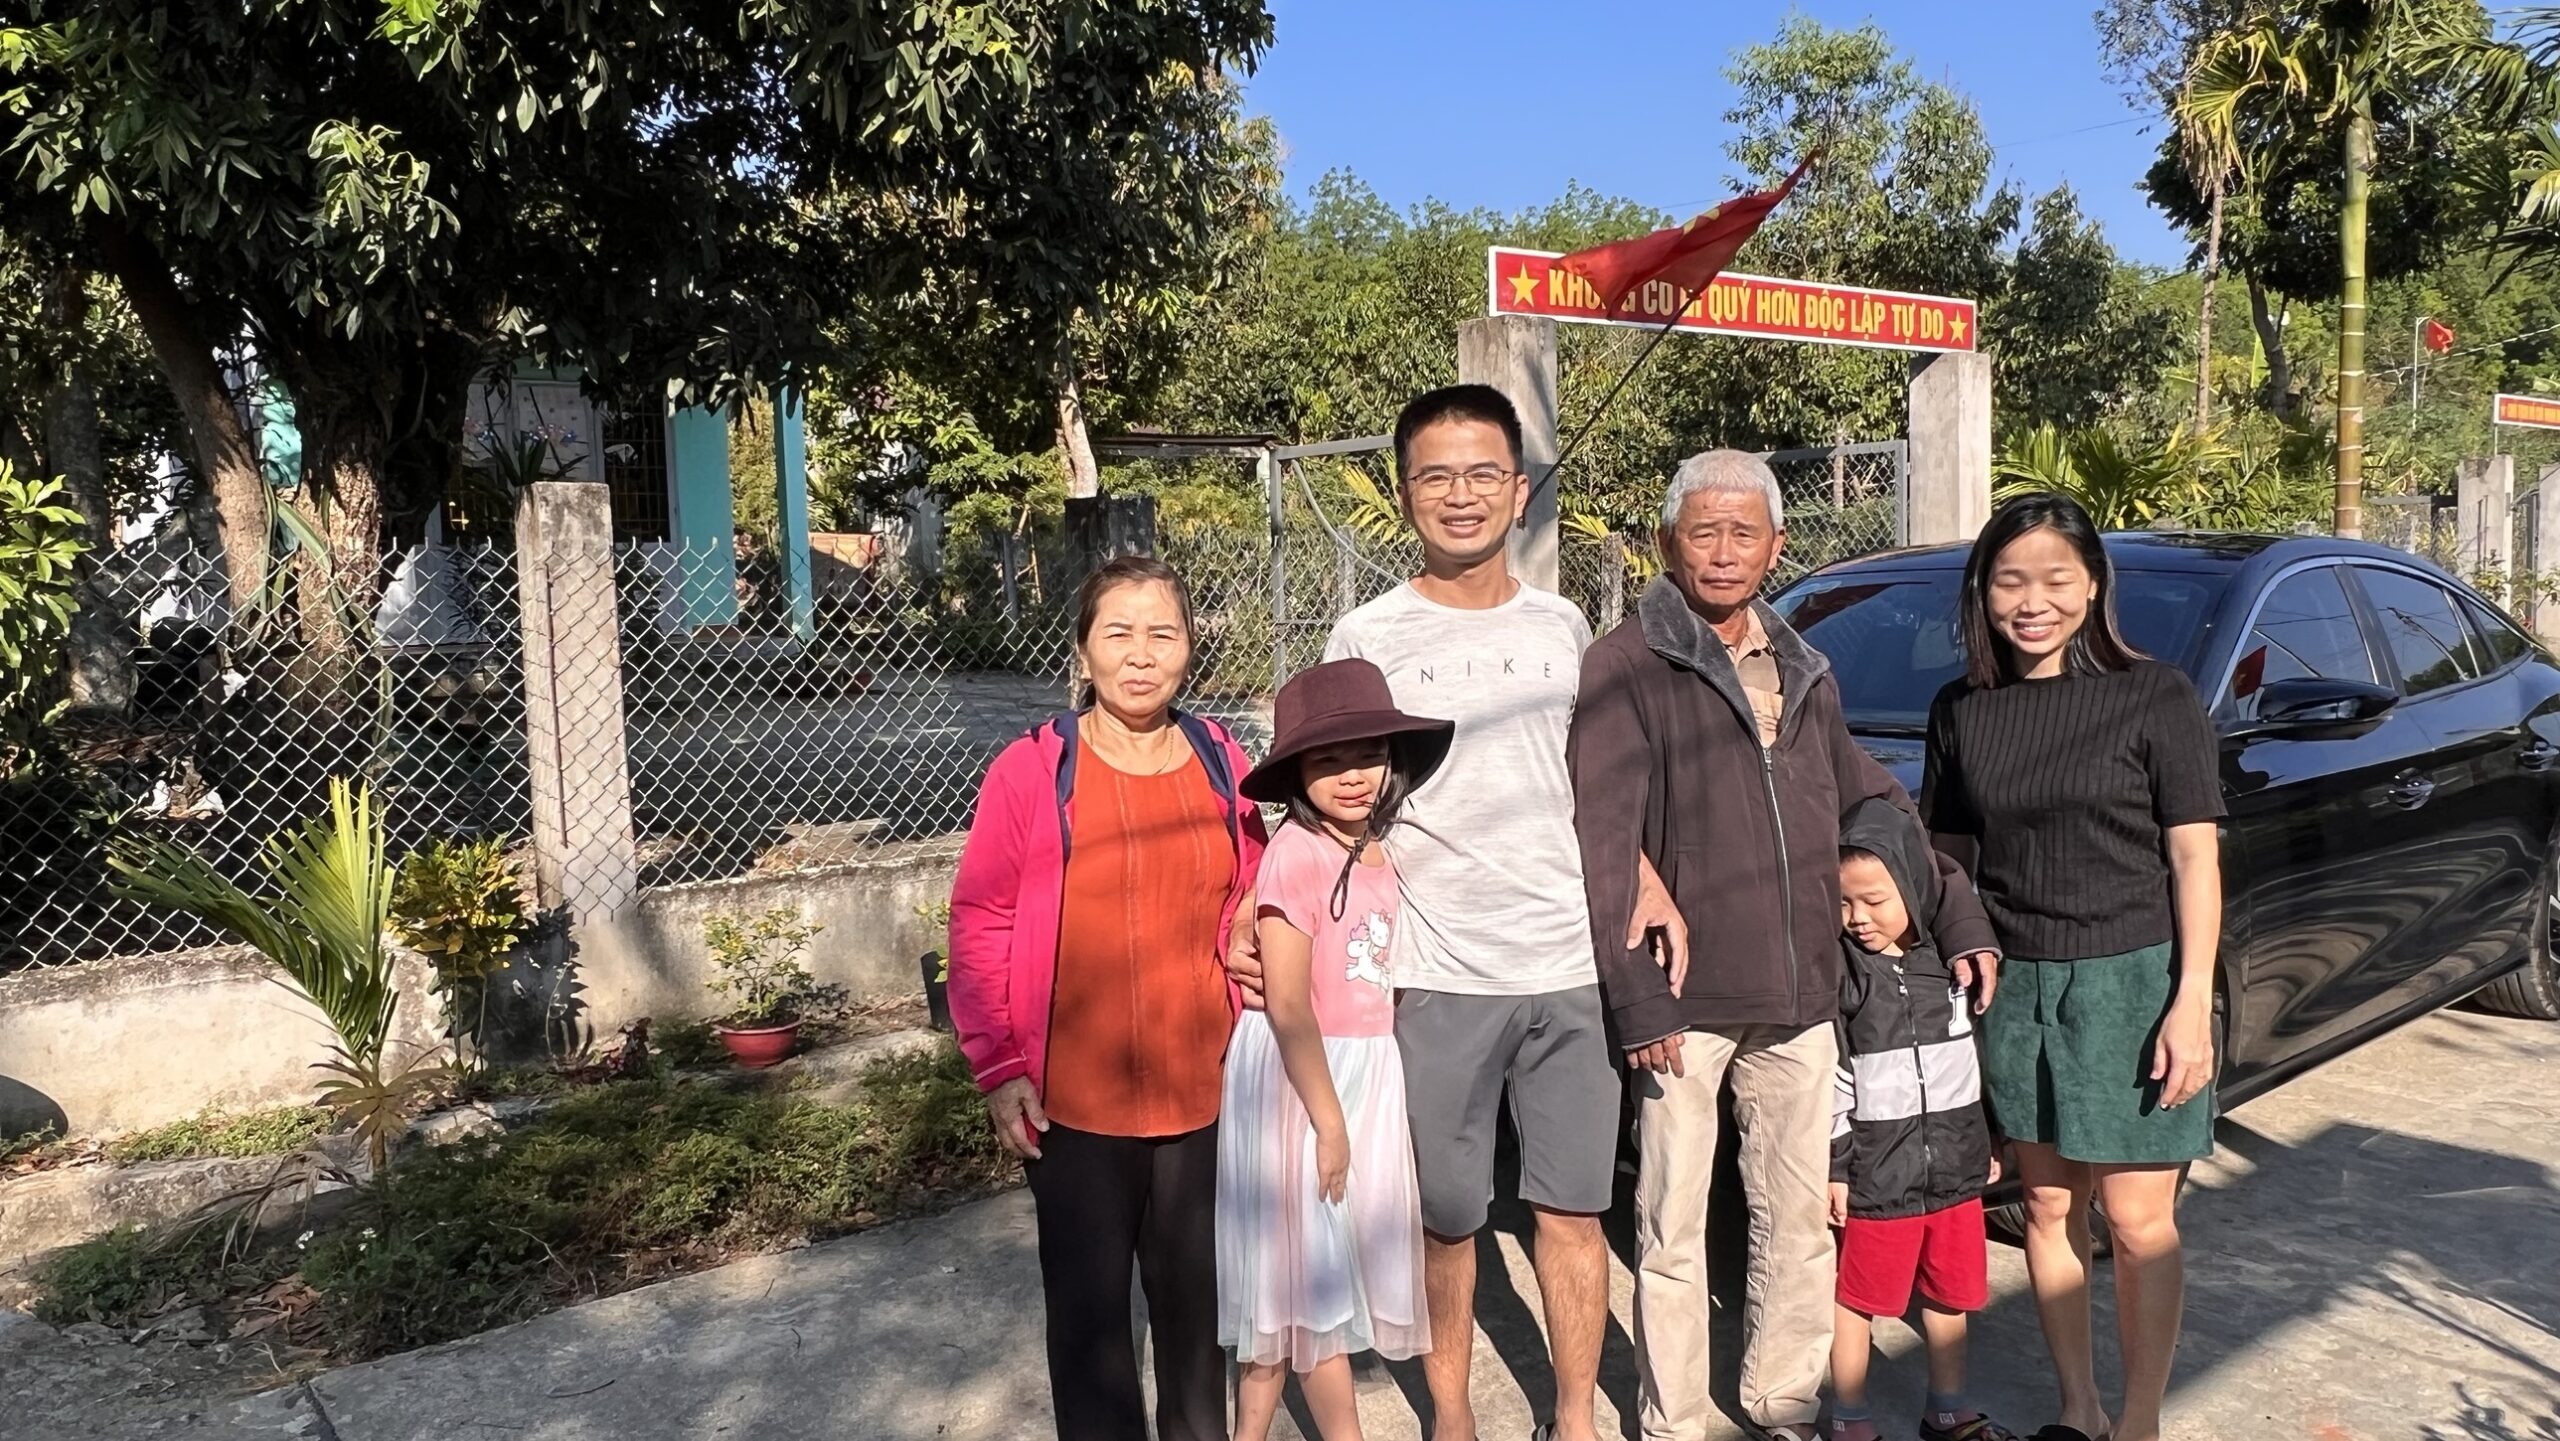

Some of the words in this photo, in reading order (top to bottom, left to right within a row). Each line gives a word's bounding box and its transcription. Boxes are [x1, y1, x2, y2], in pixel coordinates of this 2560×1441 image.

[1708, 280, 1751, 325] QUÝ
[1756, 288, 1800, 327] HƠN
[1804, 289, 1845, 337] ĐỘC
[1851, 294, 1886, 340] LẬP
[1891, 302, 1916, 344] TỰ
[1920, 307, 1944, 341] DO
[1420, 658, 1552, 684] NIKE
